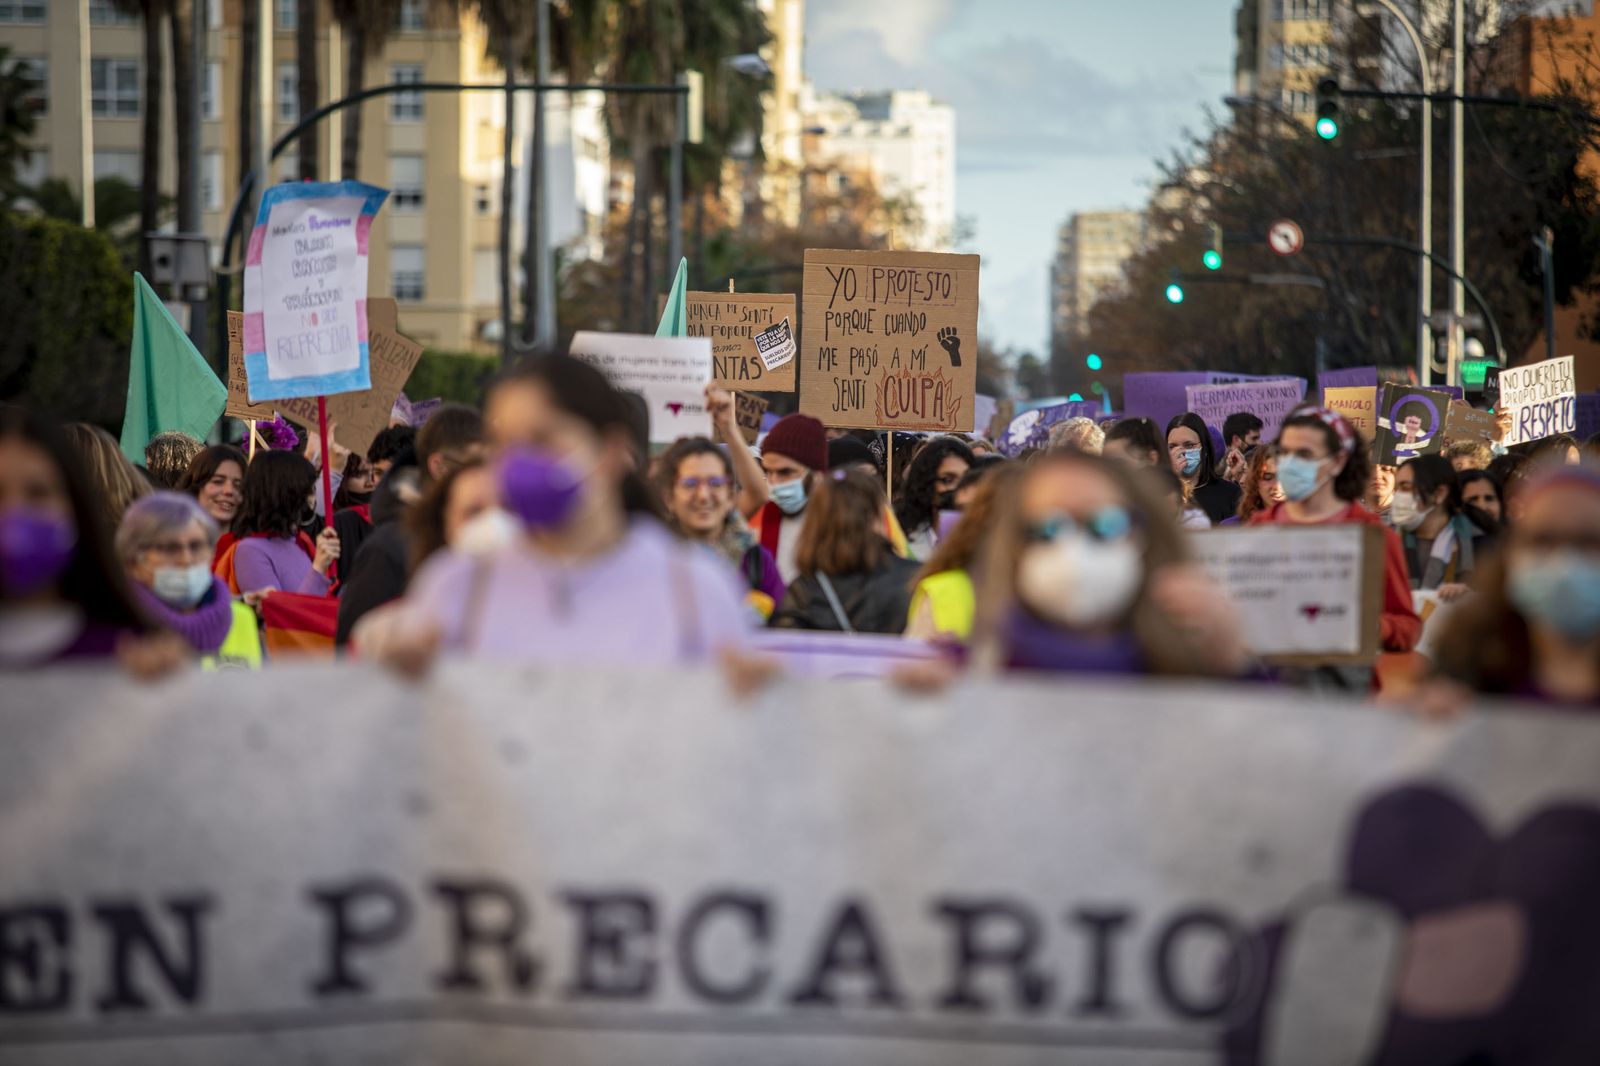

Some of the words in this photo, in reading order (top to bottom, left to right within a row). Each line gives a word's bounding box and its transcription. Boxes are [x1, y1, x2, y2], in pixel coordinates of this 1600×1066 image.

[825, 266, 857, 309] YO
[872, 268, 951, 307] PROTESTO
[686, 303, 721, 320] NUNCA
[726, 303, 737, 314] ME
[739, 306, 774, 324] SENTÍ
[825, 308, 877, 342] PORQUE
[884, 311, 927, 337] CUANDO
[687, 323, 705, 337] OLA
[711, 324, 754, 340] PORQUE
[713, 356, 762, 380] NTAS
[818, 347, 838, 372] ME
[850, 344, 878, 376] PASÓ
[890, 347, 900, 369] A
[910, 344, 929, 371] MÍ
[1504, 372, 1518, 391] NO
[1523, 364, 1556, 388] QUIERO
[1558, 360, 1570, 380] TU
[883, 375, 945, 422] CULPA
[1193, 388, 1254, 406] HERMANAS
[1266, 386, 1278, 398] NO
[1280, 385, 1297, 398] NOS
[1504, 387, 1536, 405] PIROPO
[1540, 377, 1574, 399] QUIERO
[1257, 401, 1287, 413] ENTRE
[1519, 396, 1575, 442] RESPETO
[0, 894, 213, 1016] EN
[303, 876, 1248, 1022] PRECARIO
